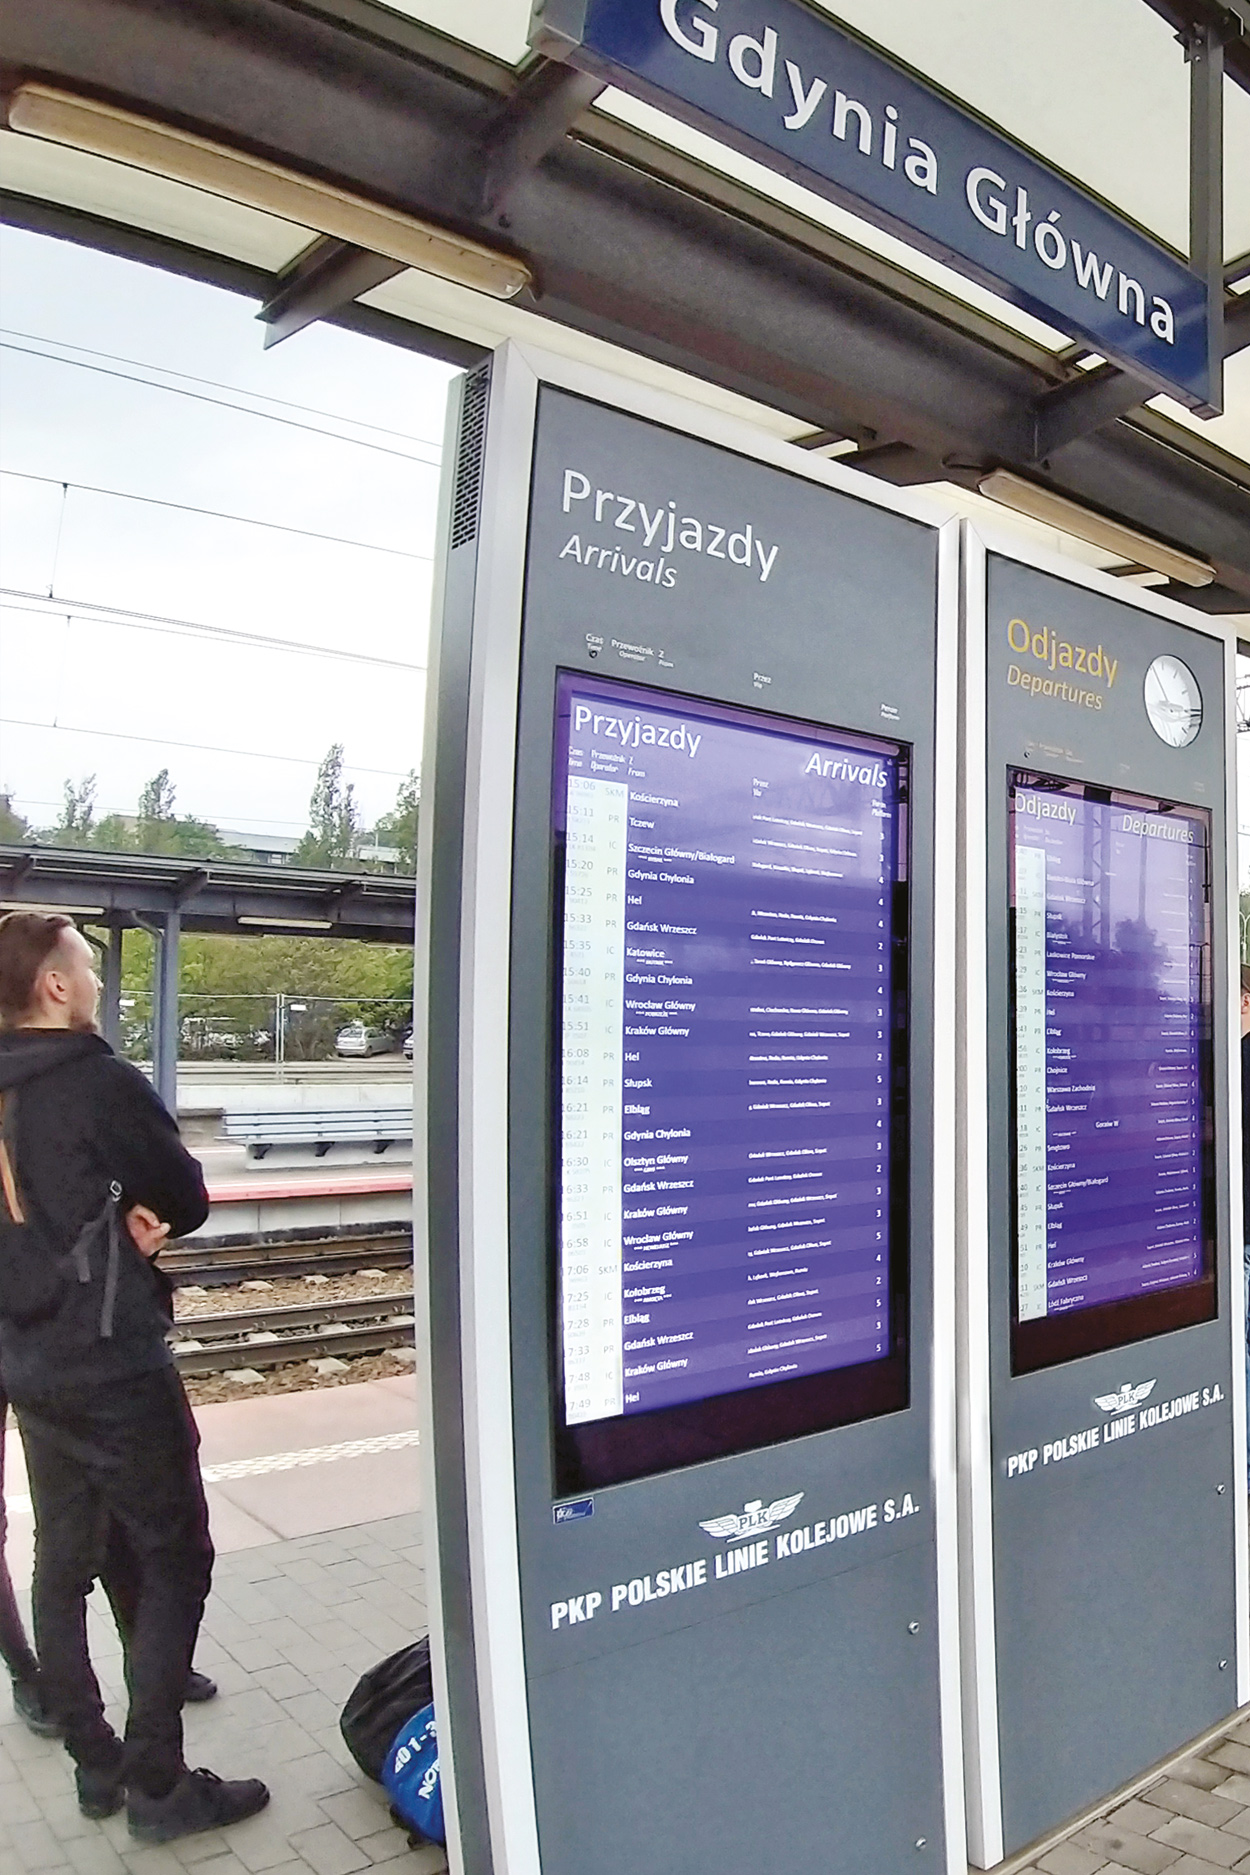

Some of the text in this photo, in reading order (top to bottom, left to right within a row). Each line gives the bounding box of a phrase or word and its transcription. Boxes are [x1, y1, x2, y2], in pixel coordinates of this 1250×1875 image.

[660, 0, 1176, 345] Gdynia Główna
[561, 468, 779, 582] Przyjazdy
[559, 534, 678, 588] Arrivals
[1007, 618, 1119, 689] Odjazdy
[1006, 663, 1103, 710] Departures
[574, 704, 702, 759] Przyjazdy
[804, 752, 889, 789] Arrivals
[1014, 791, 1077, 826] Odjazdy
[628, 816, 655, 829] Tczew
[1122, 814, 1194, 844] Departures
[627, 869, 695, 885] Gdynia Chylonia
[627, 895, 642, 905] Hel
[626, 921, 659, 933] Gdańsk
[626, 946, 666, 959] Katowice
[625, 973, 693, 986] Gdynia Chylonia
[625, 1026, 657, 1036] Kraków
[624, 1052, 640, 1062] Hel
[623, 1130, 654, 1142] Gdynia
[623, 1156, 656, 1168] Olsztyn
[623, 1209, 656, 1220] Kraków
[624, 1365, 656, 1378] Kraków
[625, 1391, 640, 1404] Hel
[1117, 1391, 1137, 1406] PLK
[1007, 1383, 1225, 1478] PKP POLSKIE LINIE KOLEJOWE S.A.
[738, 1510, 769, 1531] PLK
[550, 1492, 921, 1631] PKP POLSKIE LINIE KOLEJOWE S.A.
